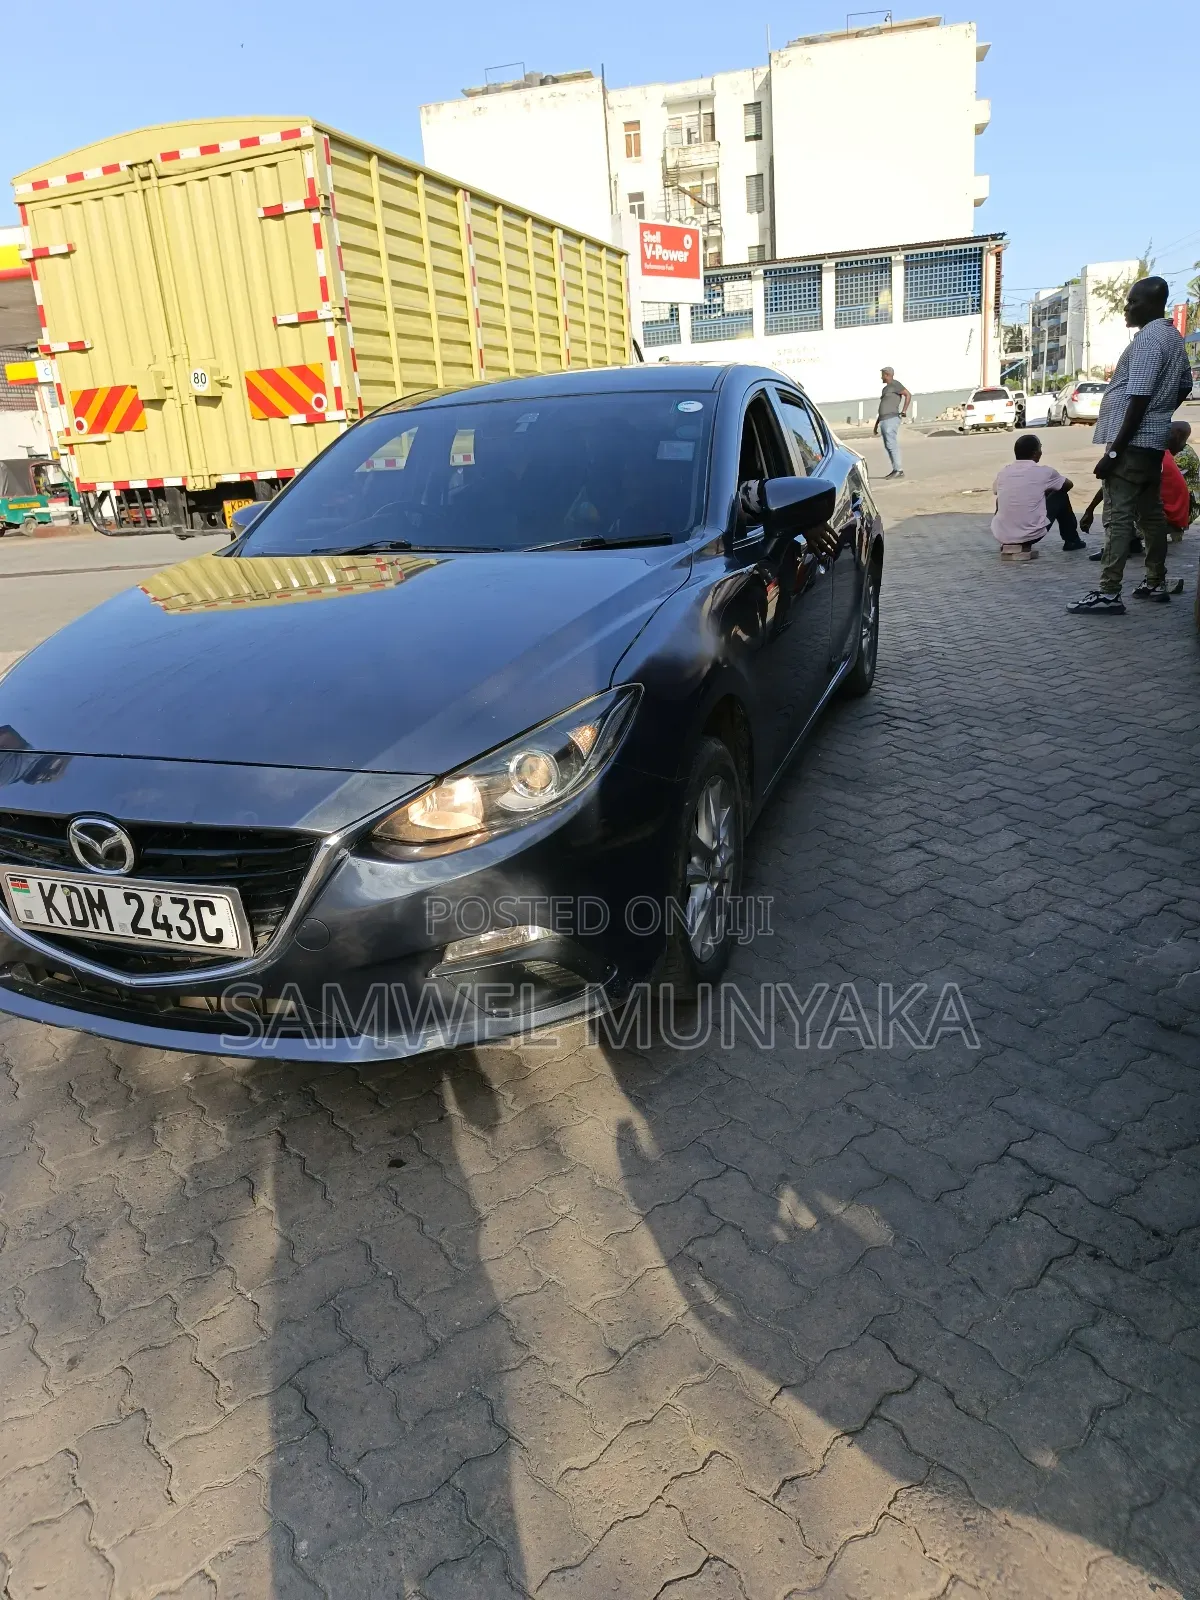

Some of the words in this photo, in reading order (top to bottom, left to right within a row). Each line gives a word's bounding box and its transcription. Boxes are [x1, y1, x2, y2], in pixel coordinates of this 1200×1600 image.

[643, 230, 661, 243] Shell
[643, 243, 689, 263] V-Power
[193, 372, 207, 385] 80
[37, 881, 115, 932] KDM
[123, 891, 224, 944] 243C
